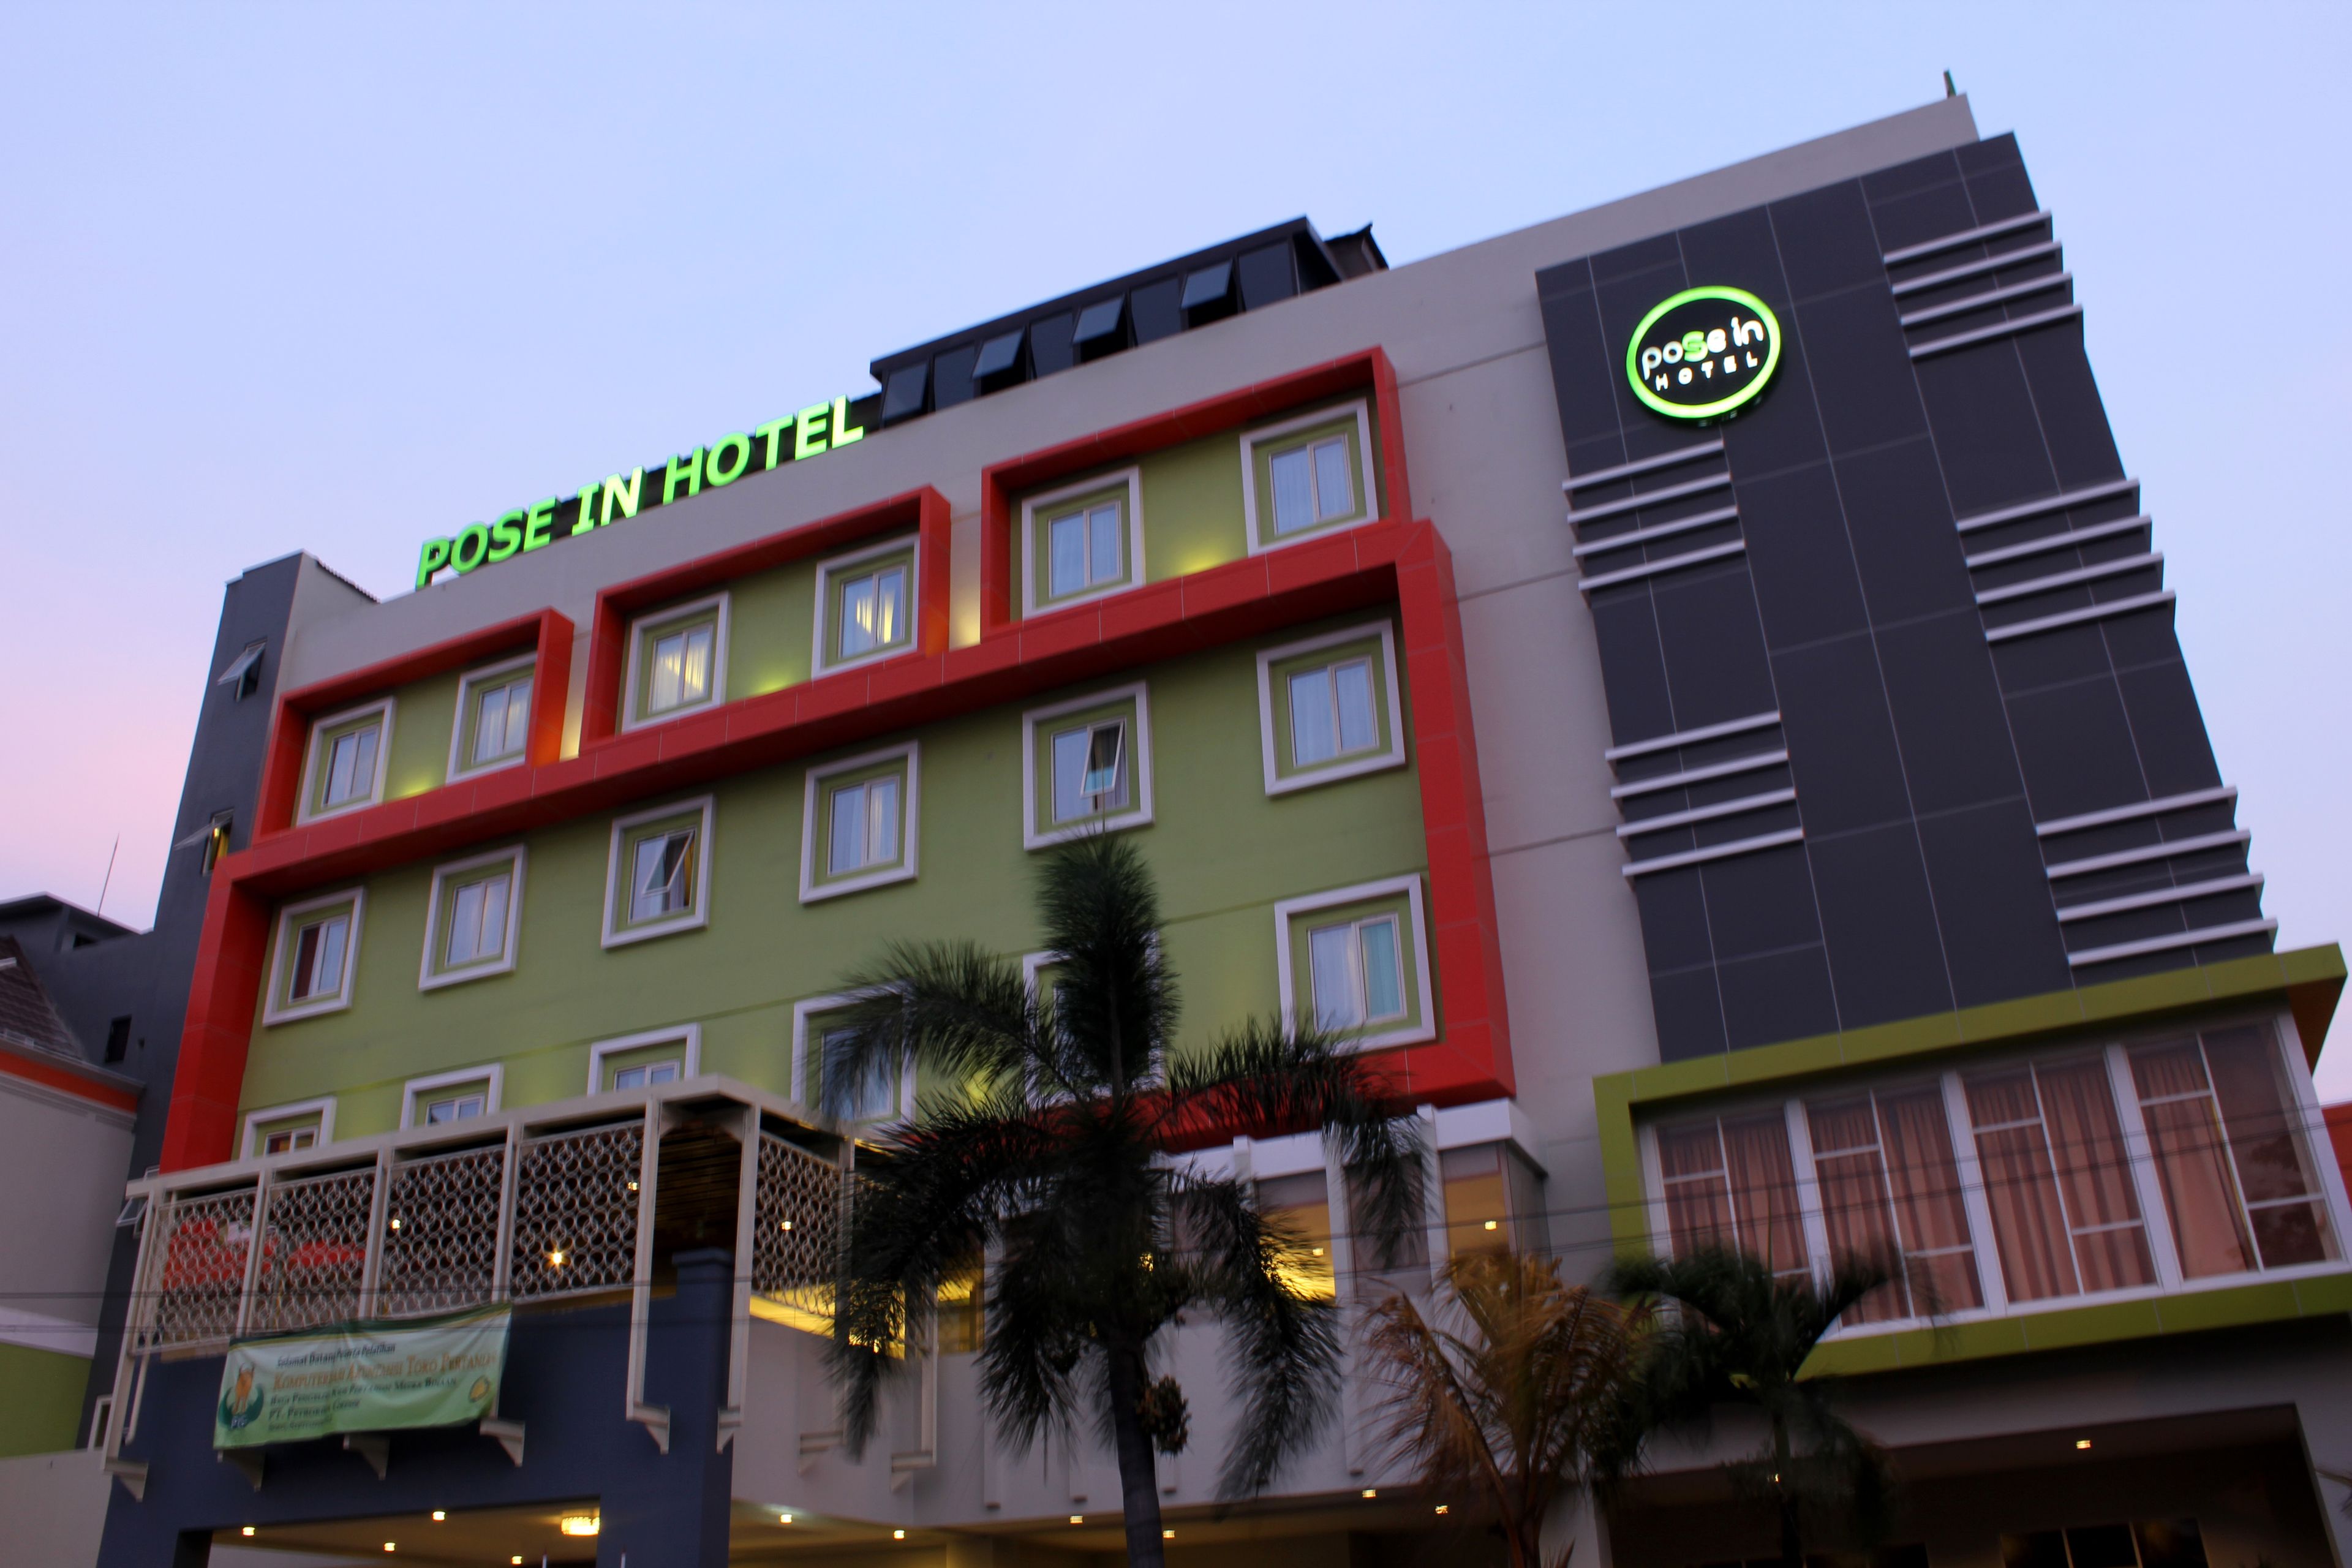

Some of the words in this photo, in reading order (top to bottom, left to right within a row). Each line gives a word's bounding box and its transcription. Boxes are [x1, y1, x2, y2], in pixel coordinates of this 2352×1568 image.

[1642, 328, 1727, 380] pose
[1730, 316, 1763, 347] in
[1655, 351, 1758, 391] HOTEL
[415, 496, 557, 592] POSE
[571, 466, 644, 536] IN
[663, 394, 864, 505] HOTEL
[407, 1354, 438, 1376] TOKO
